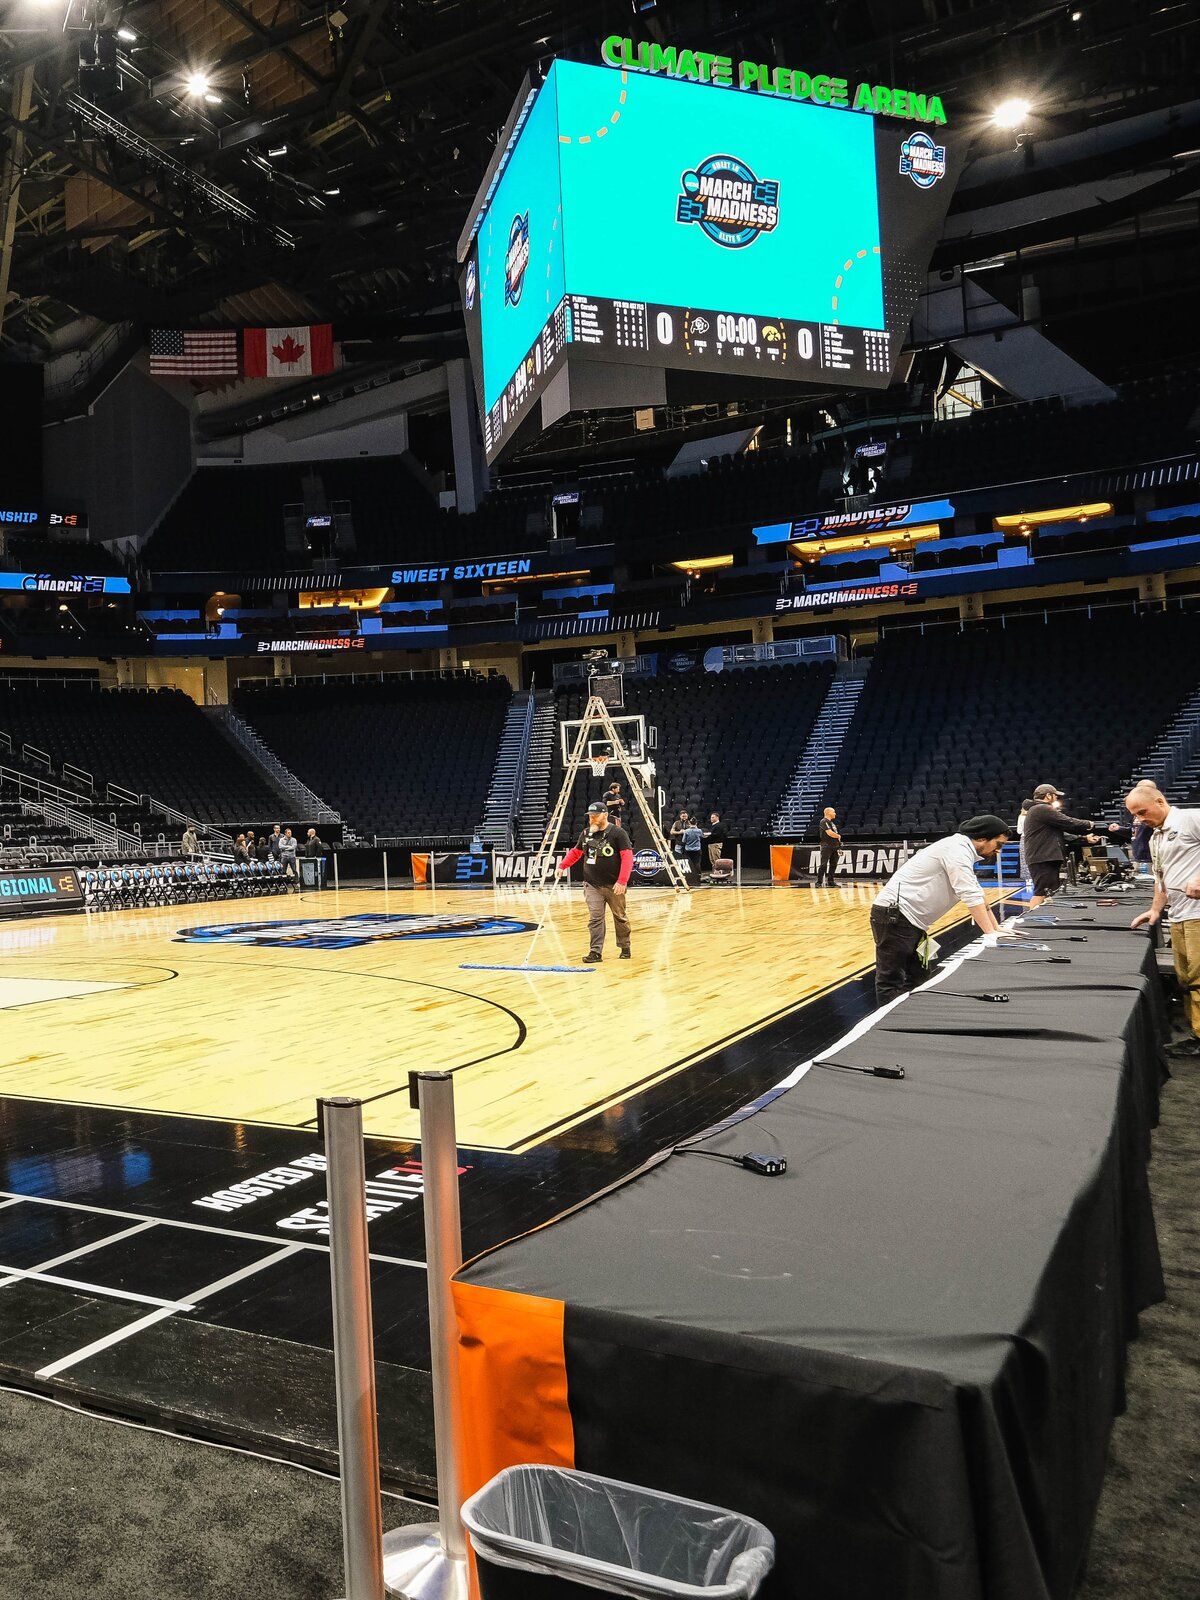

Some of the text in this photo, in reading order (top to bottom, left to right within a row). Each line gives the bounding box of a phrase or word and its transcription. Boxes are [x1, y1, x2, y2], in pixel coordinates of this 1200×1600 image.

[601, 35, 947, 125] CLIMATE PLEDGE ARENA
[700, 176, 752, 202] MARCH
[707, 197, 777, 225] MADNESS
[657, 312, 673, 345] 0
[716, 314, 757, 345] 60:00
[797, 327, 813, 360] 0
[38, 579, 81, 592] MARCH
[391, 558, 531, 585] SWEET SIXTEEN
[496, 855, 567, 878] MARCH
[192, 1166, 314, 1212] HOSTED
